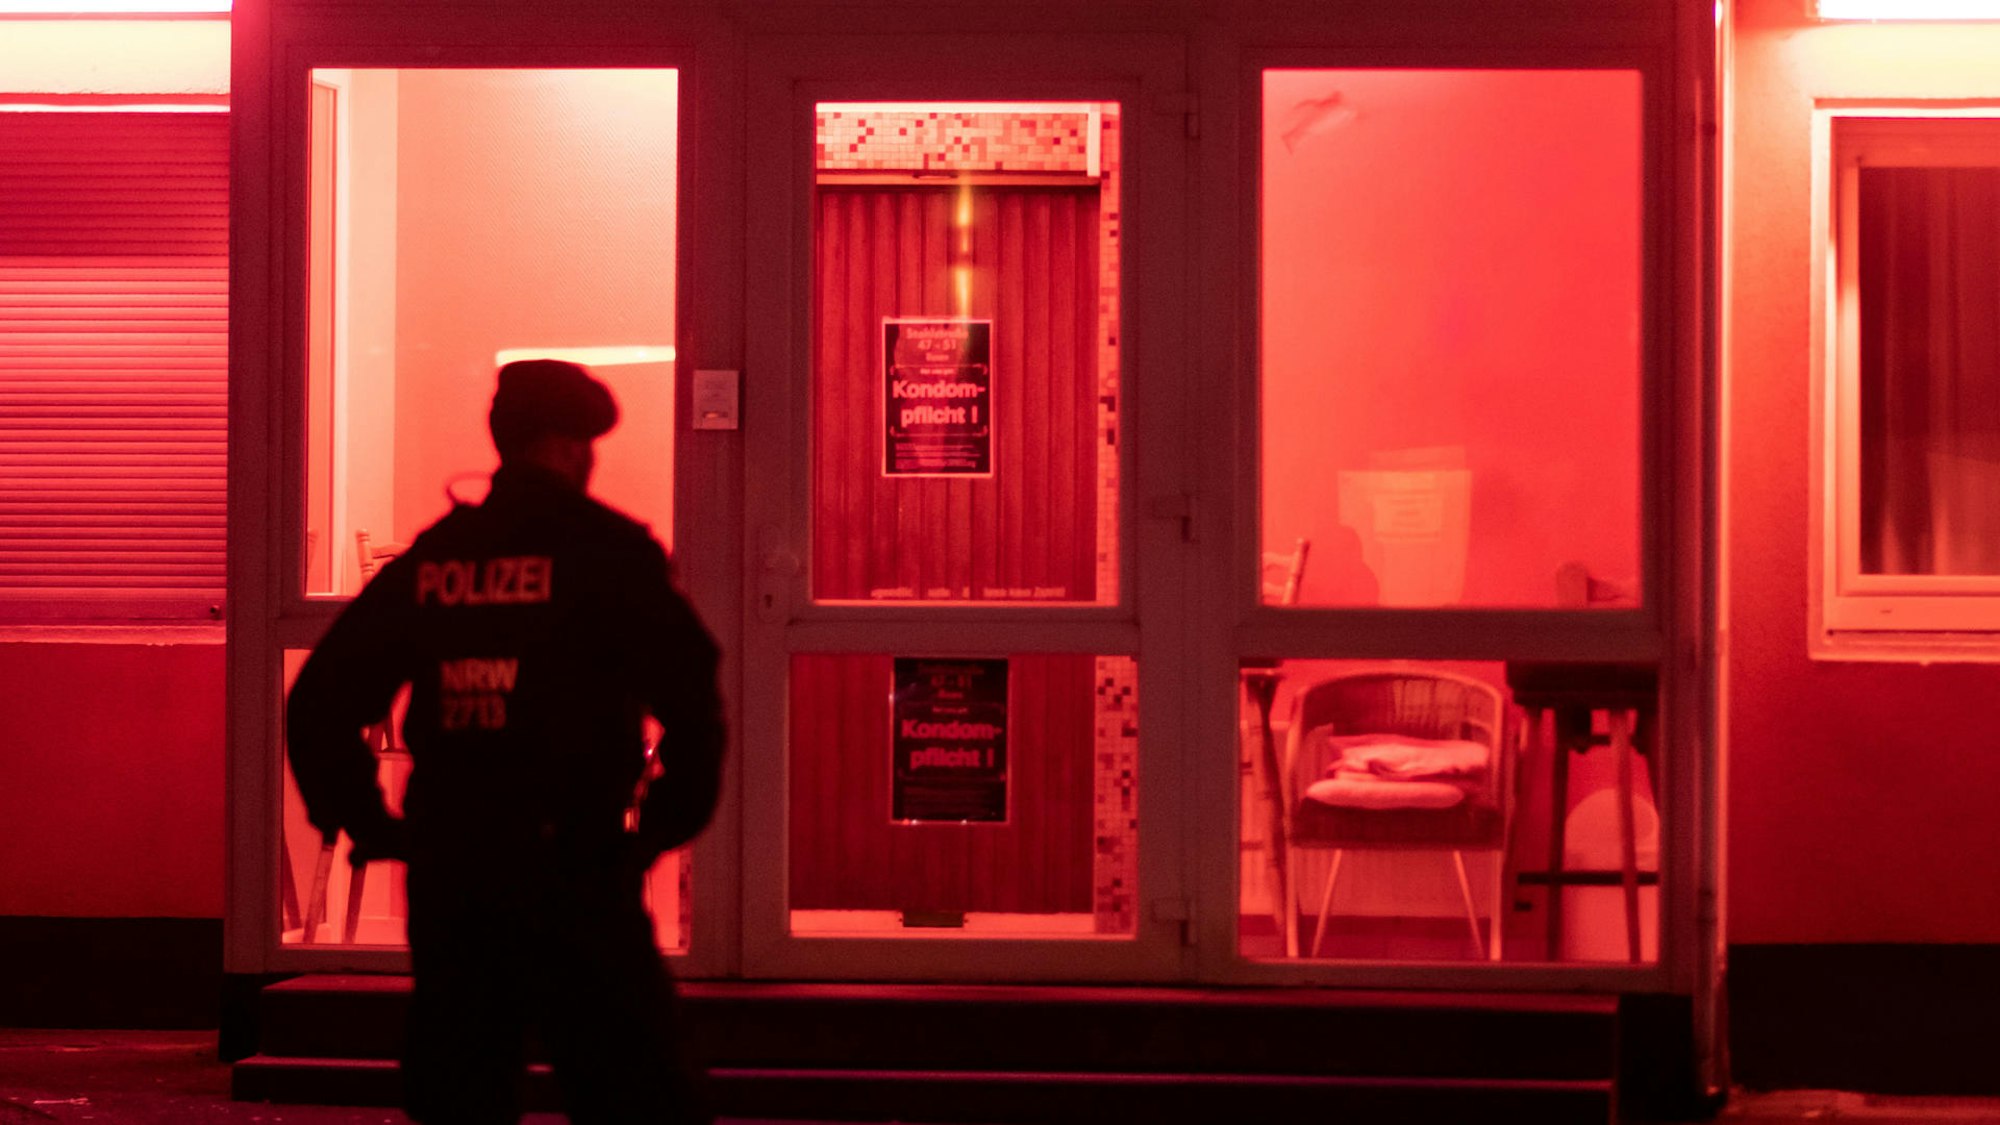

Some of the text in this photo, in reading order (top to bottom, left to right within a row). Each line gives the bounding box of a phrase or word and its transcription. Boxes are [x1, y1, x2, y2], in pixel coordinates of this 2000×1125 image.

[893, 381, 986, 398] Kondom-
[901, 406, 966, 427] pflicht
[418, 557, 552, 605] POLIZEI
[441, 658, 518, 691] NRW
[902, 720, 1002, 739] Kondom-
[910, 748, 979, 769] pflicht
